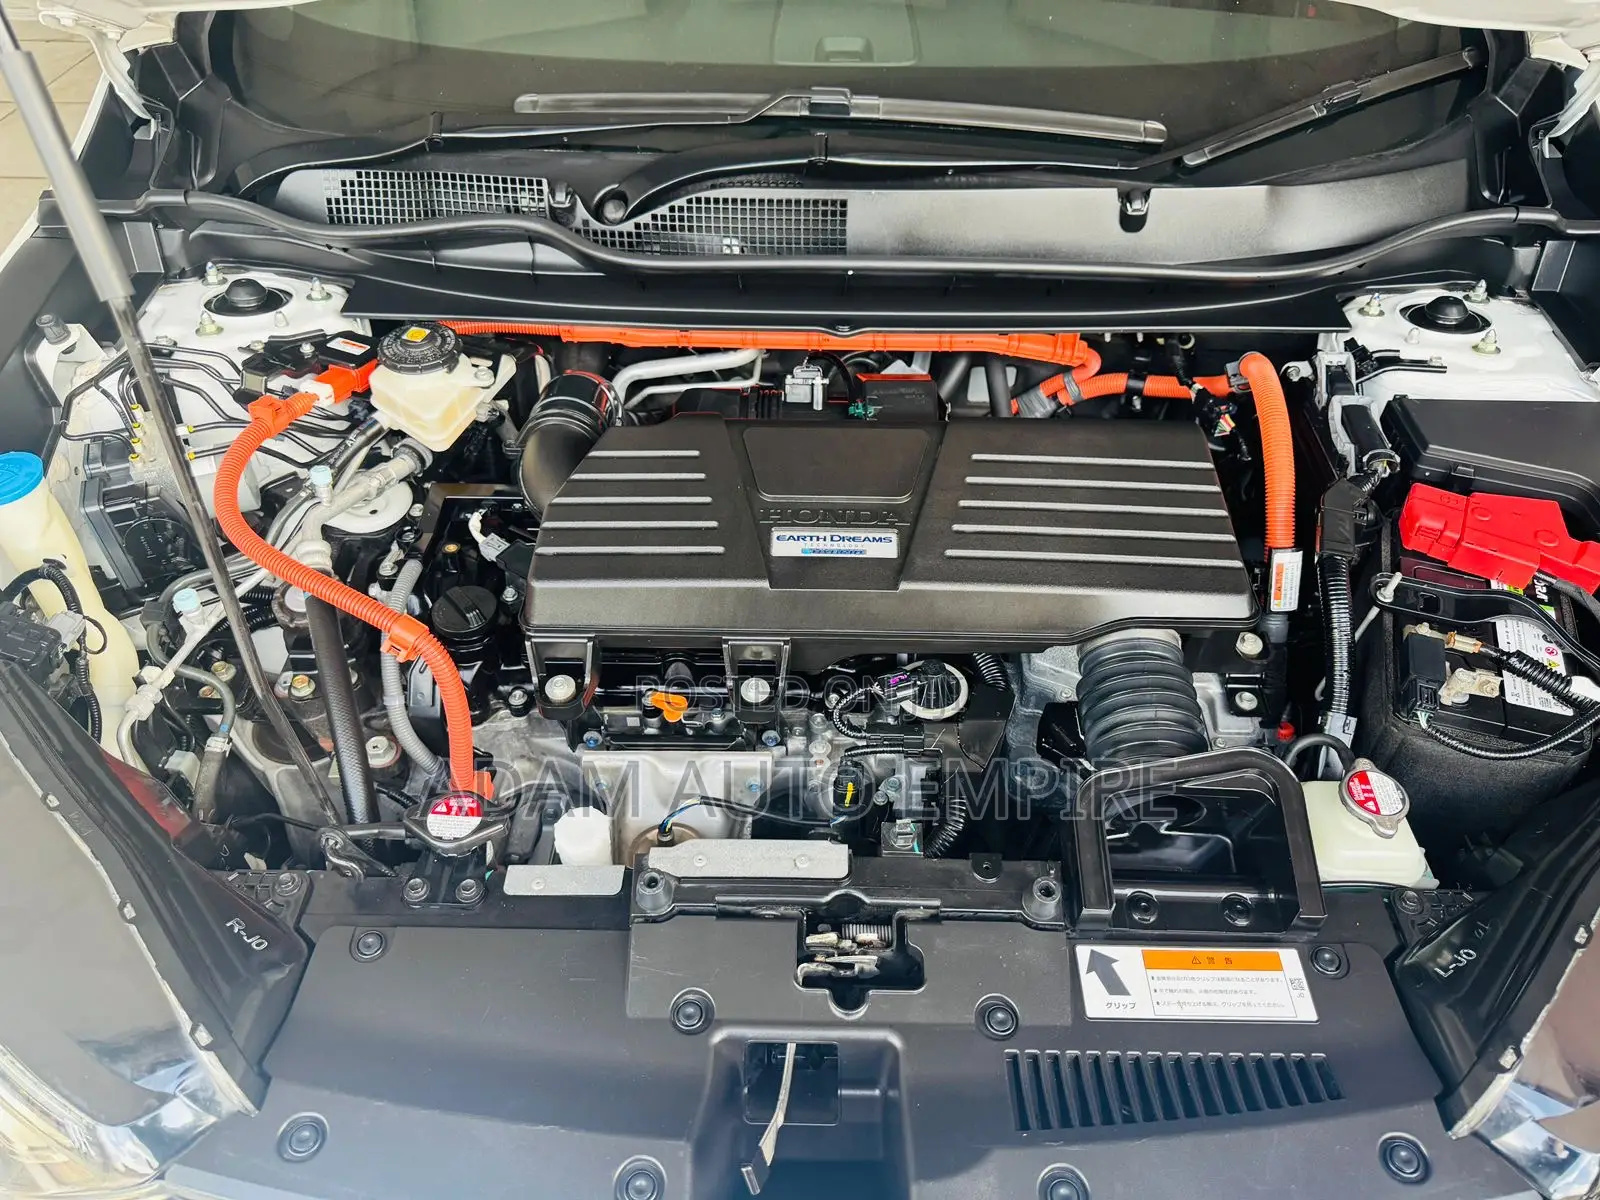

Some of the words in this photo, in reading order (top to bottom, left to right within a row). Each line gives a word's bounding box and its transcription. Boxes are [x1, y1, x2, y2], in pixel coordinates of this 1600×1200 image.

[759, 509, 911, 525] HONDA
[776, 534, 826, 543] EARTH
[830, 534, 893, 544] DREAMS
